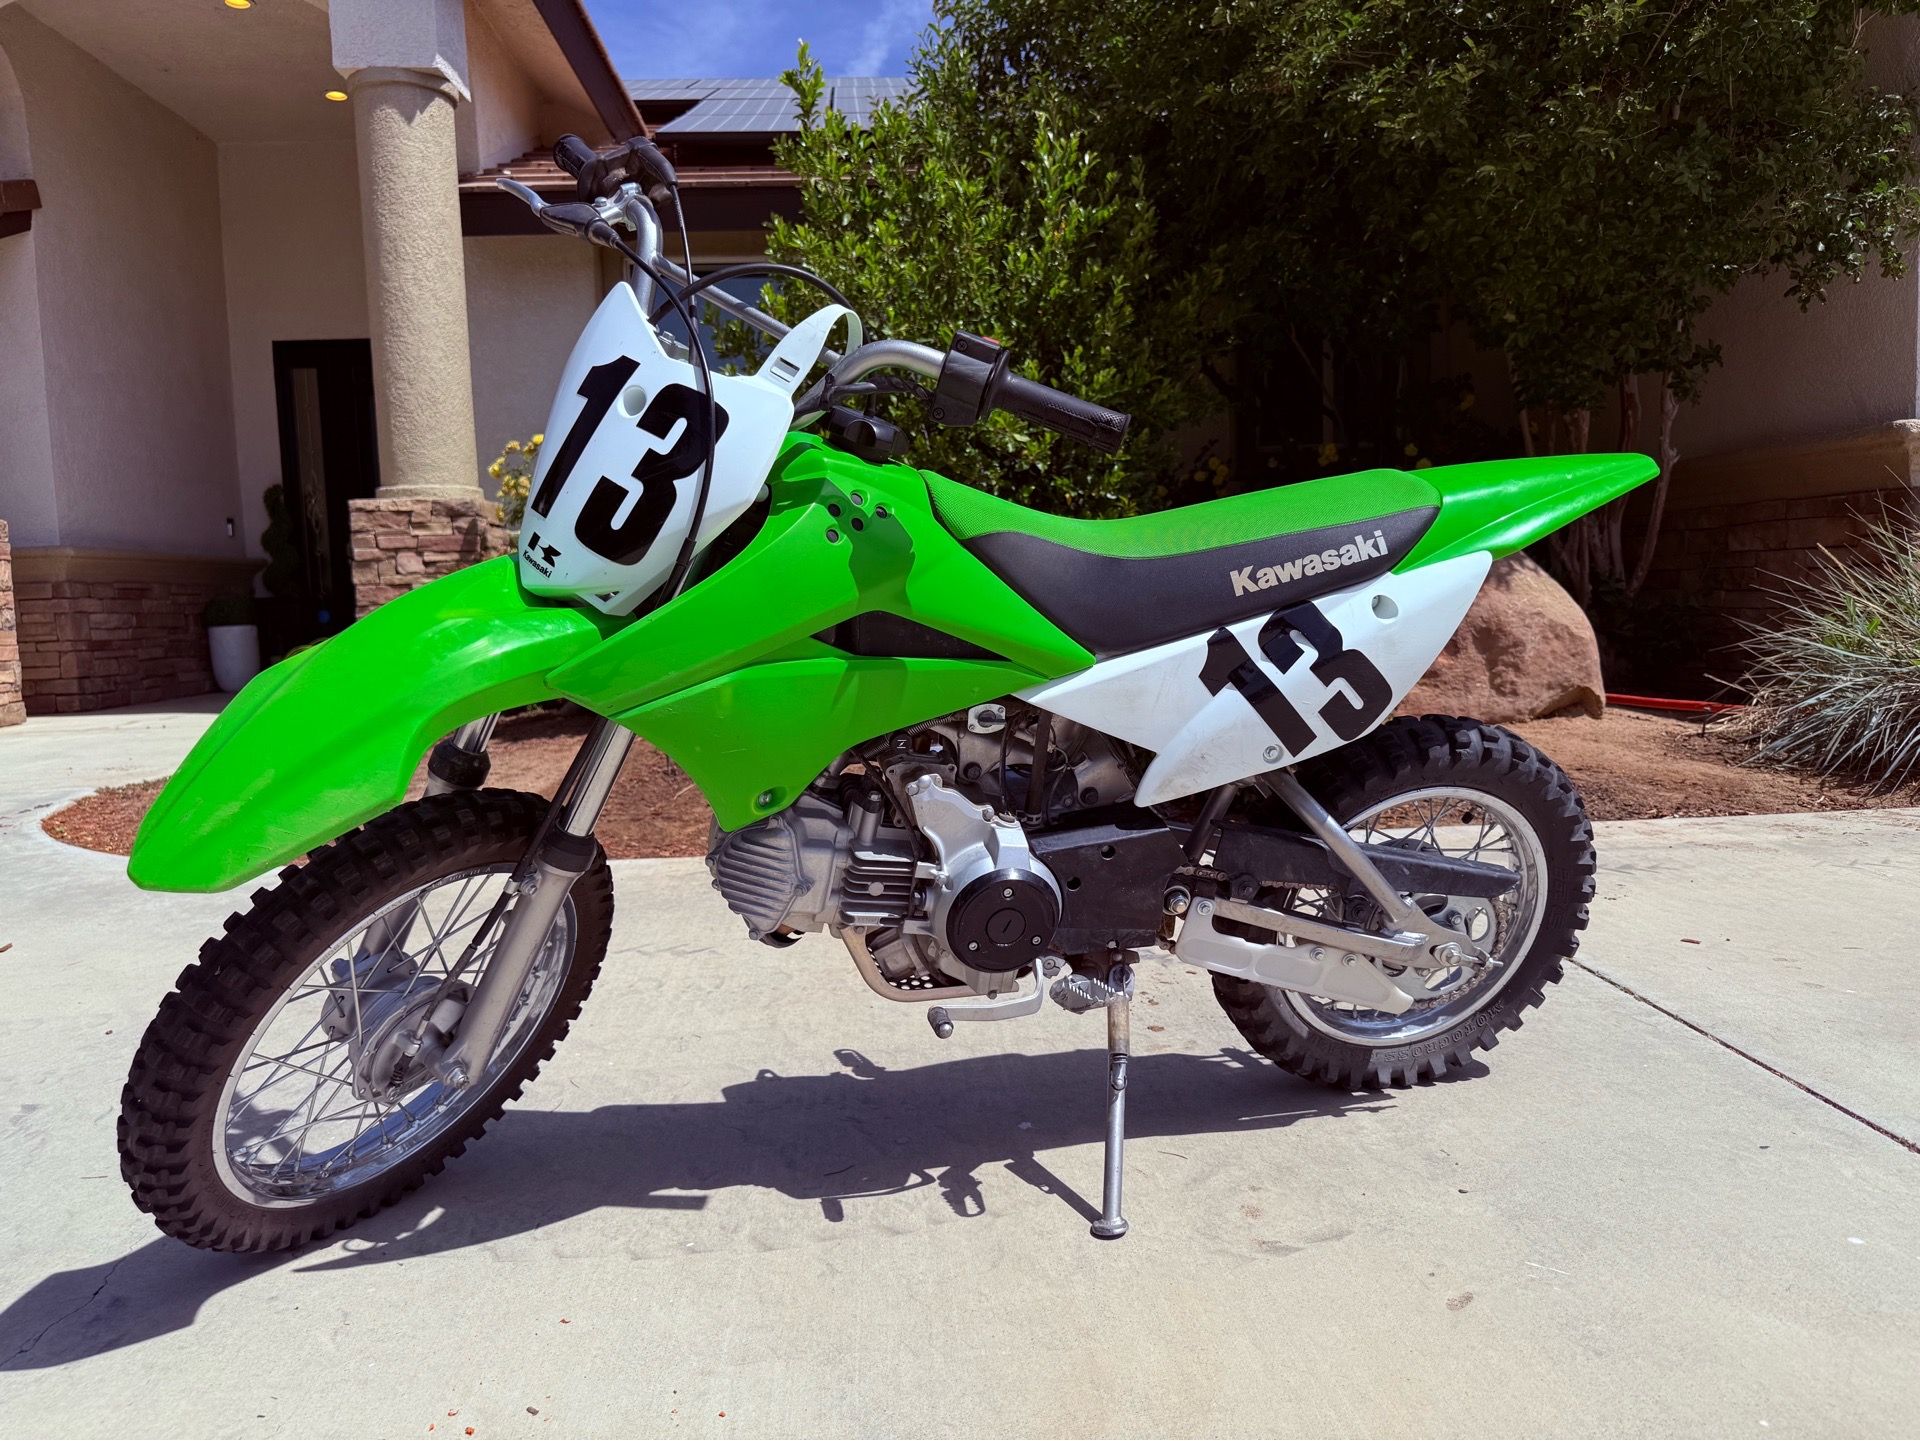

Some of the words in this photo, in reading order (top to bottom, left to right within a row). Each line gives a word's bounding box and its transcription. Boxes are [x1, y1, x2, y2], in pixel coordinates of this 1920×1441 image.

[530, 355, 730, 566] 13
[522, 550, 553, 578] Kawasaki
[1229, 530, 1389, 597] Kawasaki
[1198, 600, 1393, 758] 13
[1384, 1001, 1504, 1063] MOTOCROSS
